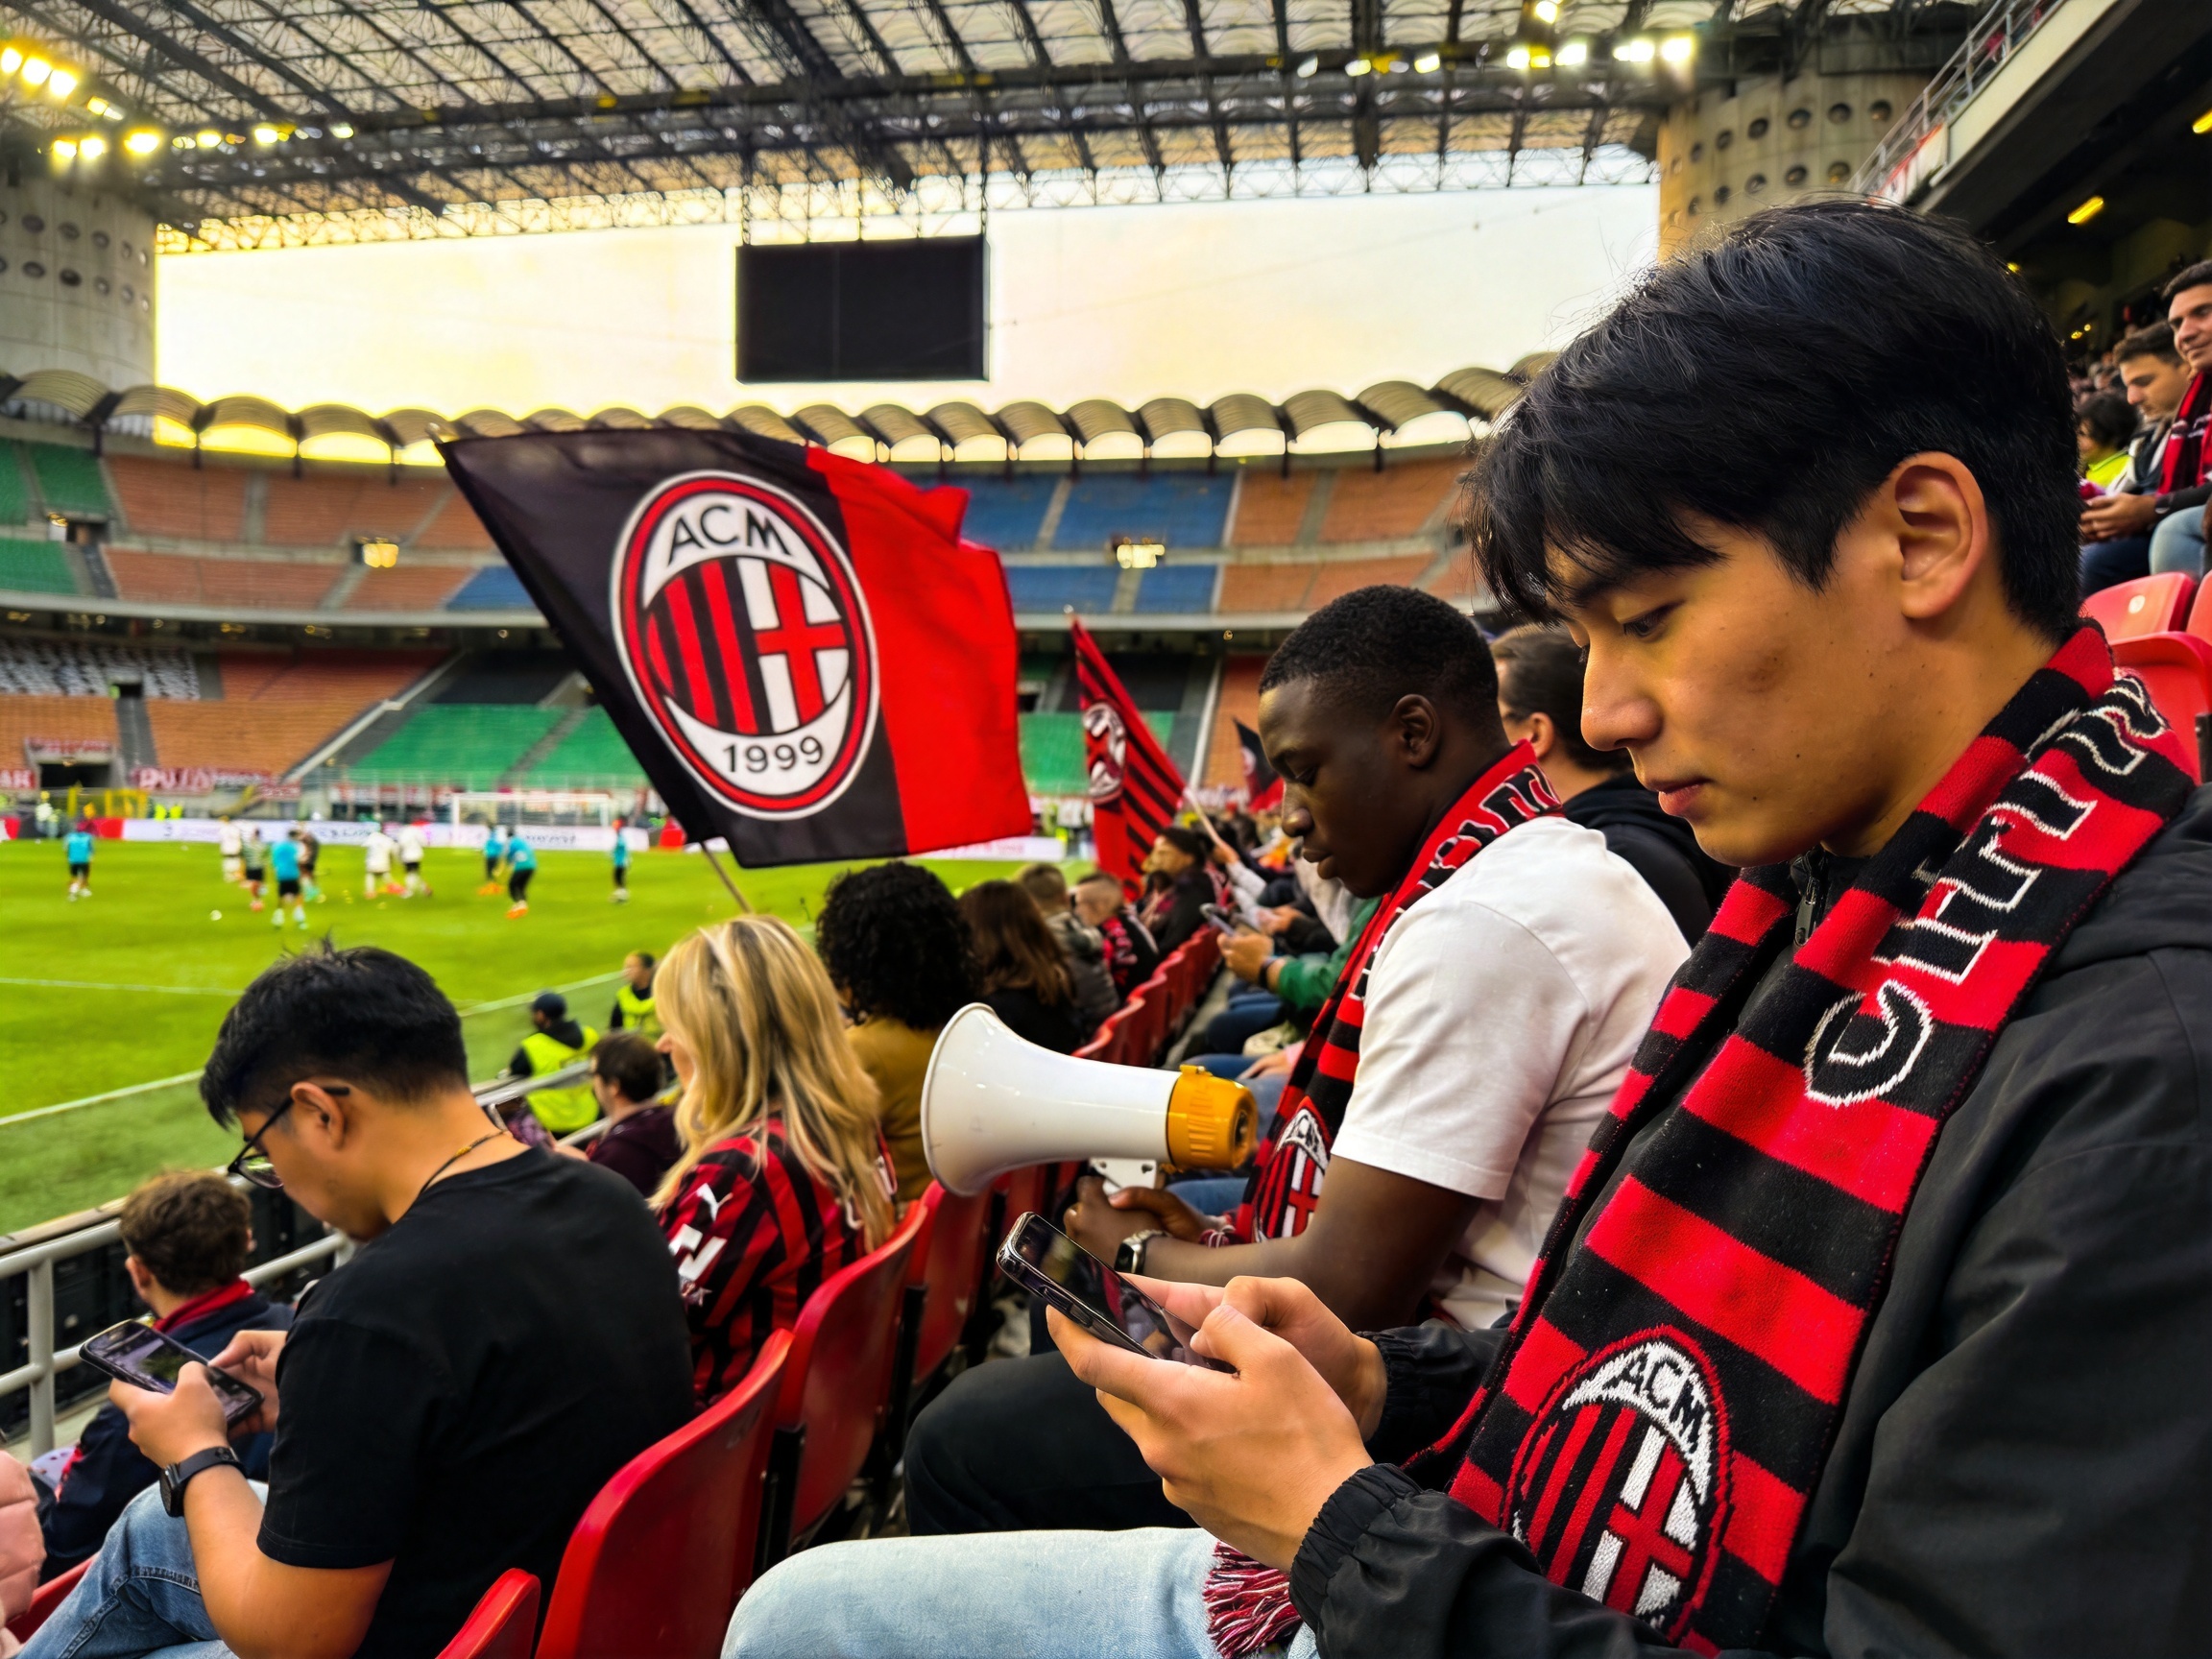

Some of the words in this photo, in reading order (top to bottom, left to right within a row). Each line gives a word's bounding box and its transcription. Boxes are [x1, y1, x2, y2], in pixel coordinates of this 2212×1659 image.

[666, 504, 792, 568] ACM
[723, 735, 824, 774] 1999
[1601, 1352, 1703, 1455] ACM
